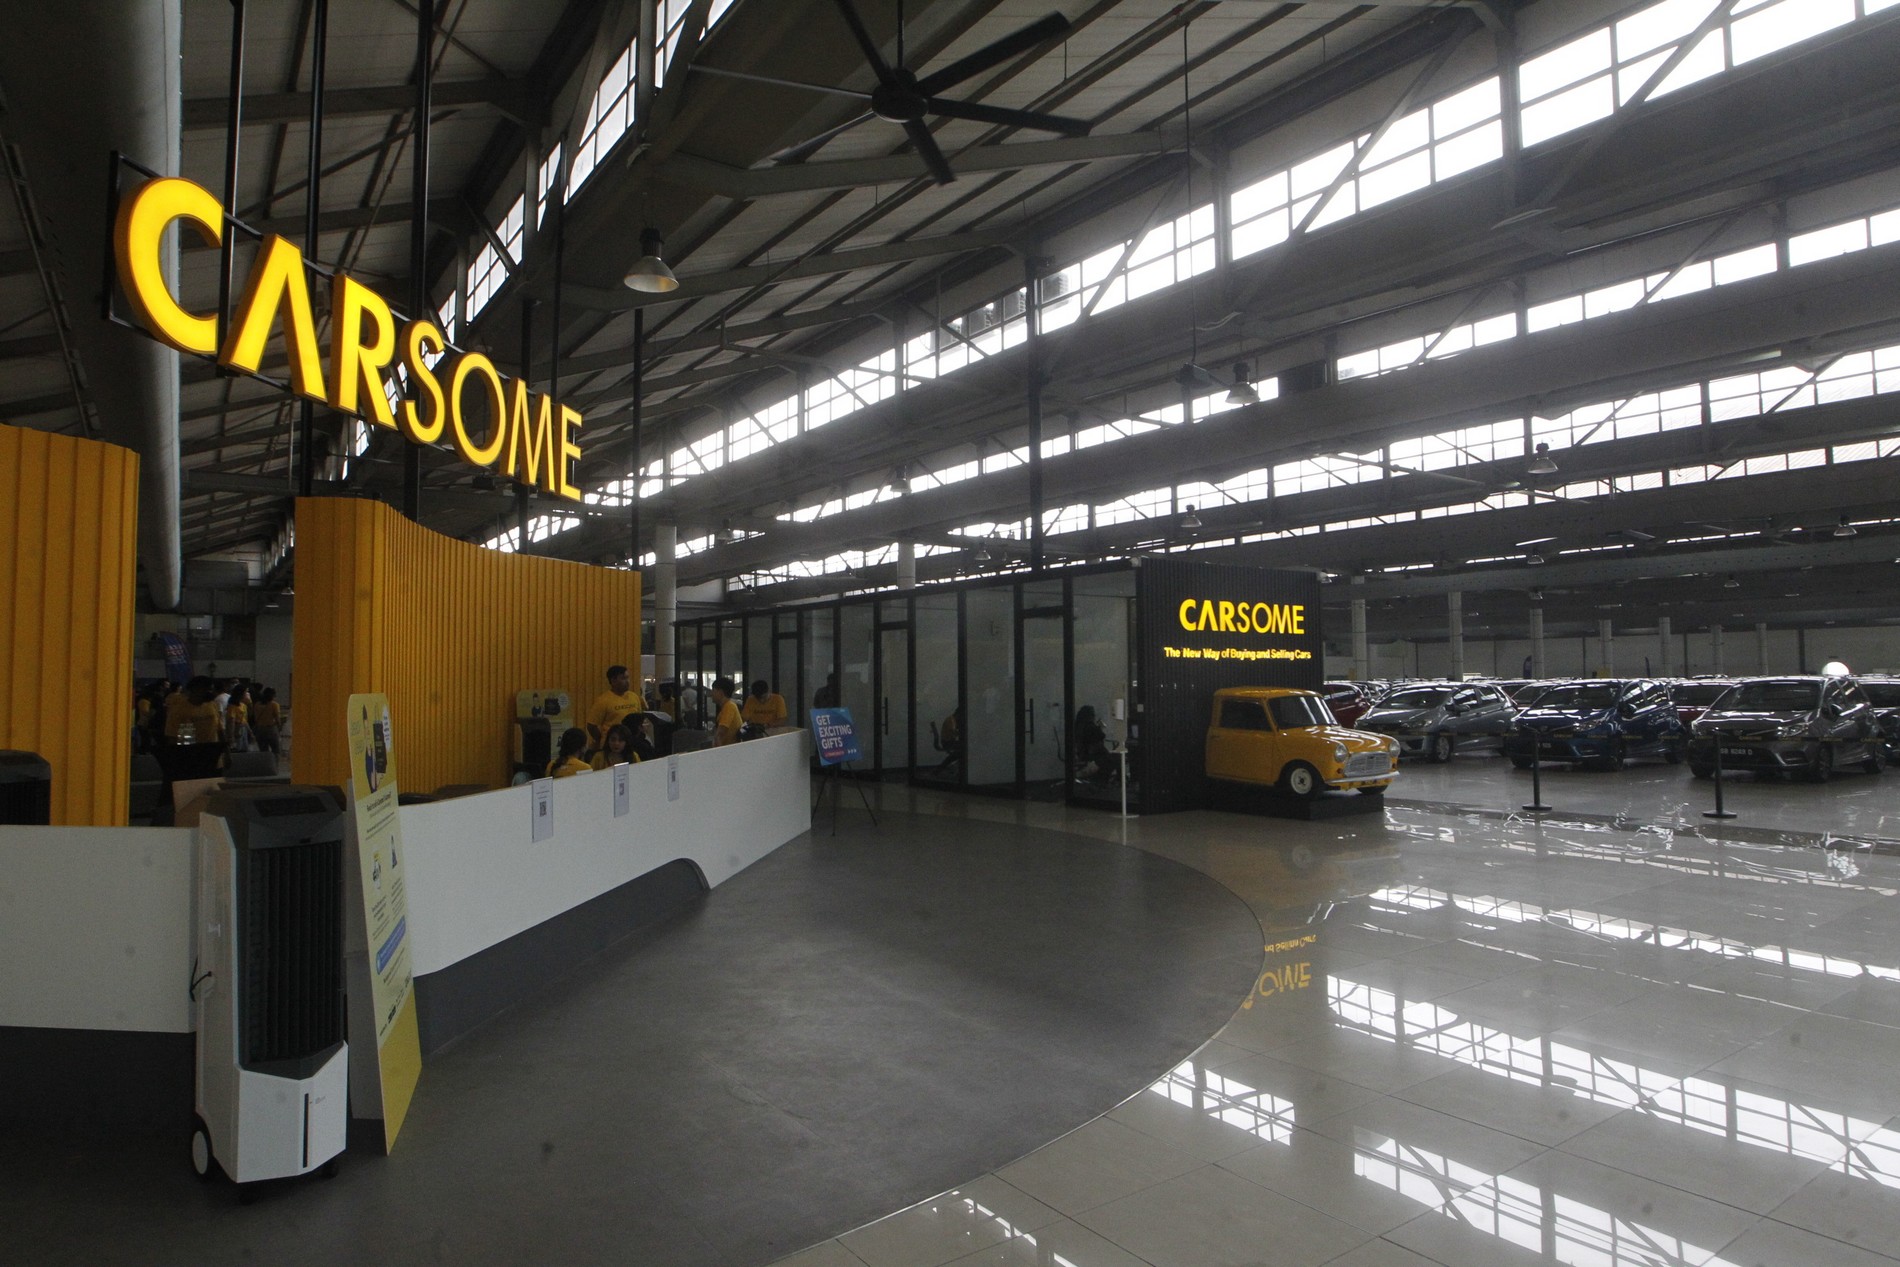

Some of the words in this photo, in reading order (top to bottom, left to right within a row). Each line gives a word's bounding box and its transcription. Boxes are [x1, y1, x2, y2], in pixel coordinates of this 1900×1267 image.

[114, 176, 583, 502] CARSOME
[1179, 598, 1305, 634] CARSOME
[1164, 647, 1180, 658] The
[1182, 647, 1201, 658] New
[1203, 648, 1220, 661] Way
[1221, 648, 1230, 658] of
[1230, 648, 1255, 661] Buying
[1256, 649, 1270, 659] and
[1271, 649, 1294, 661] Selling
[1295, 649, 1312, 660] Cars
[816, 714, 831, 726] GET
[818, 724, 852, 738] EXCITING
[821, 737, 843, 749] GIFTS
